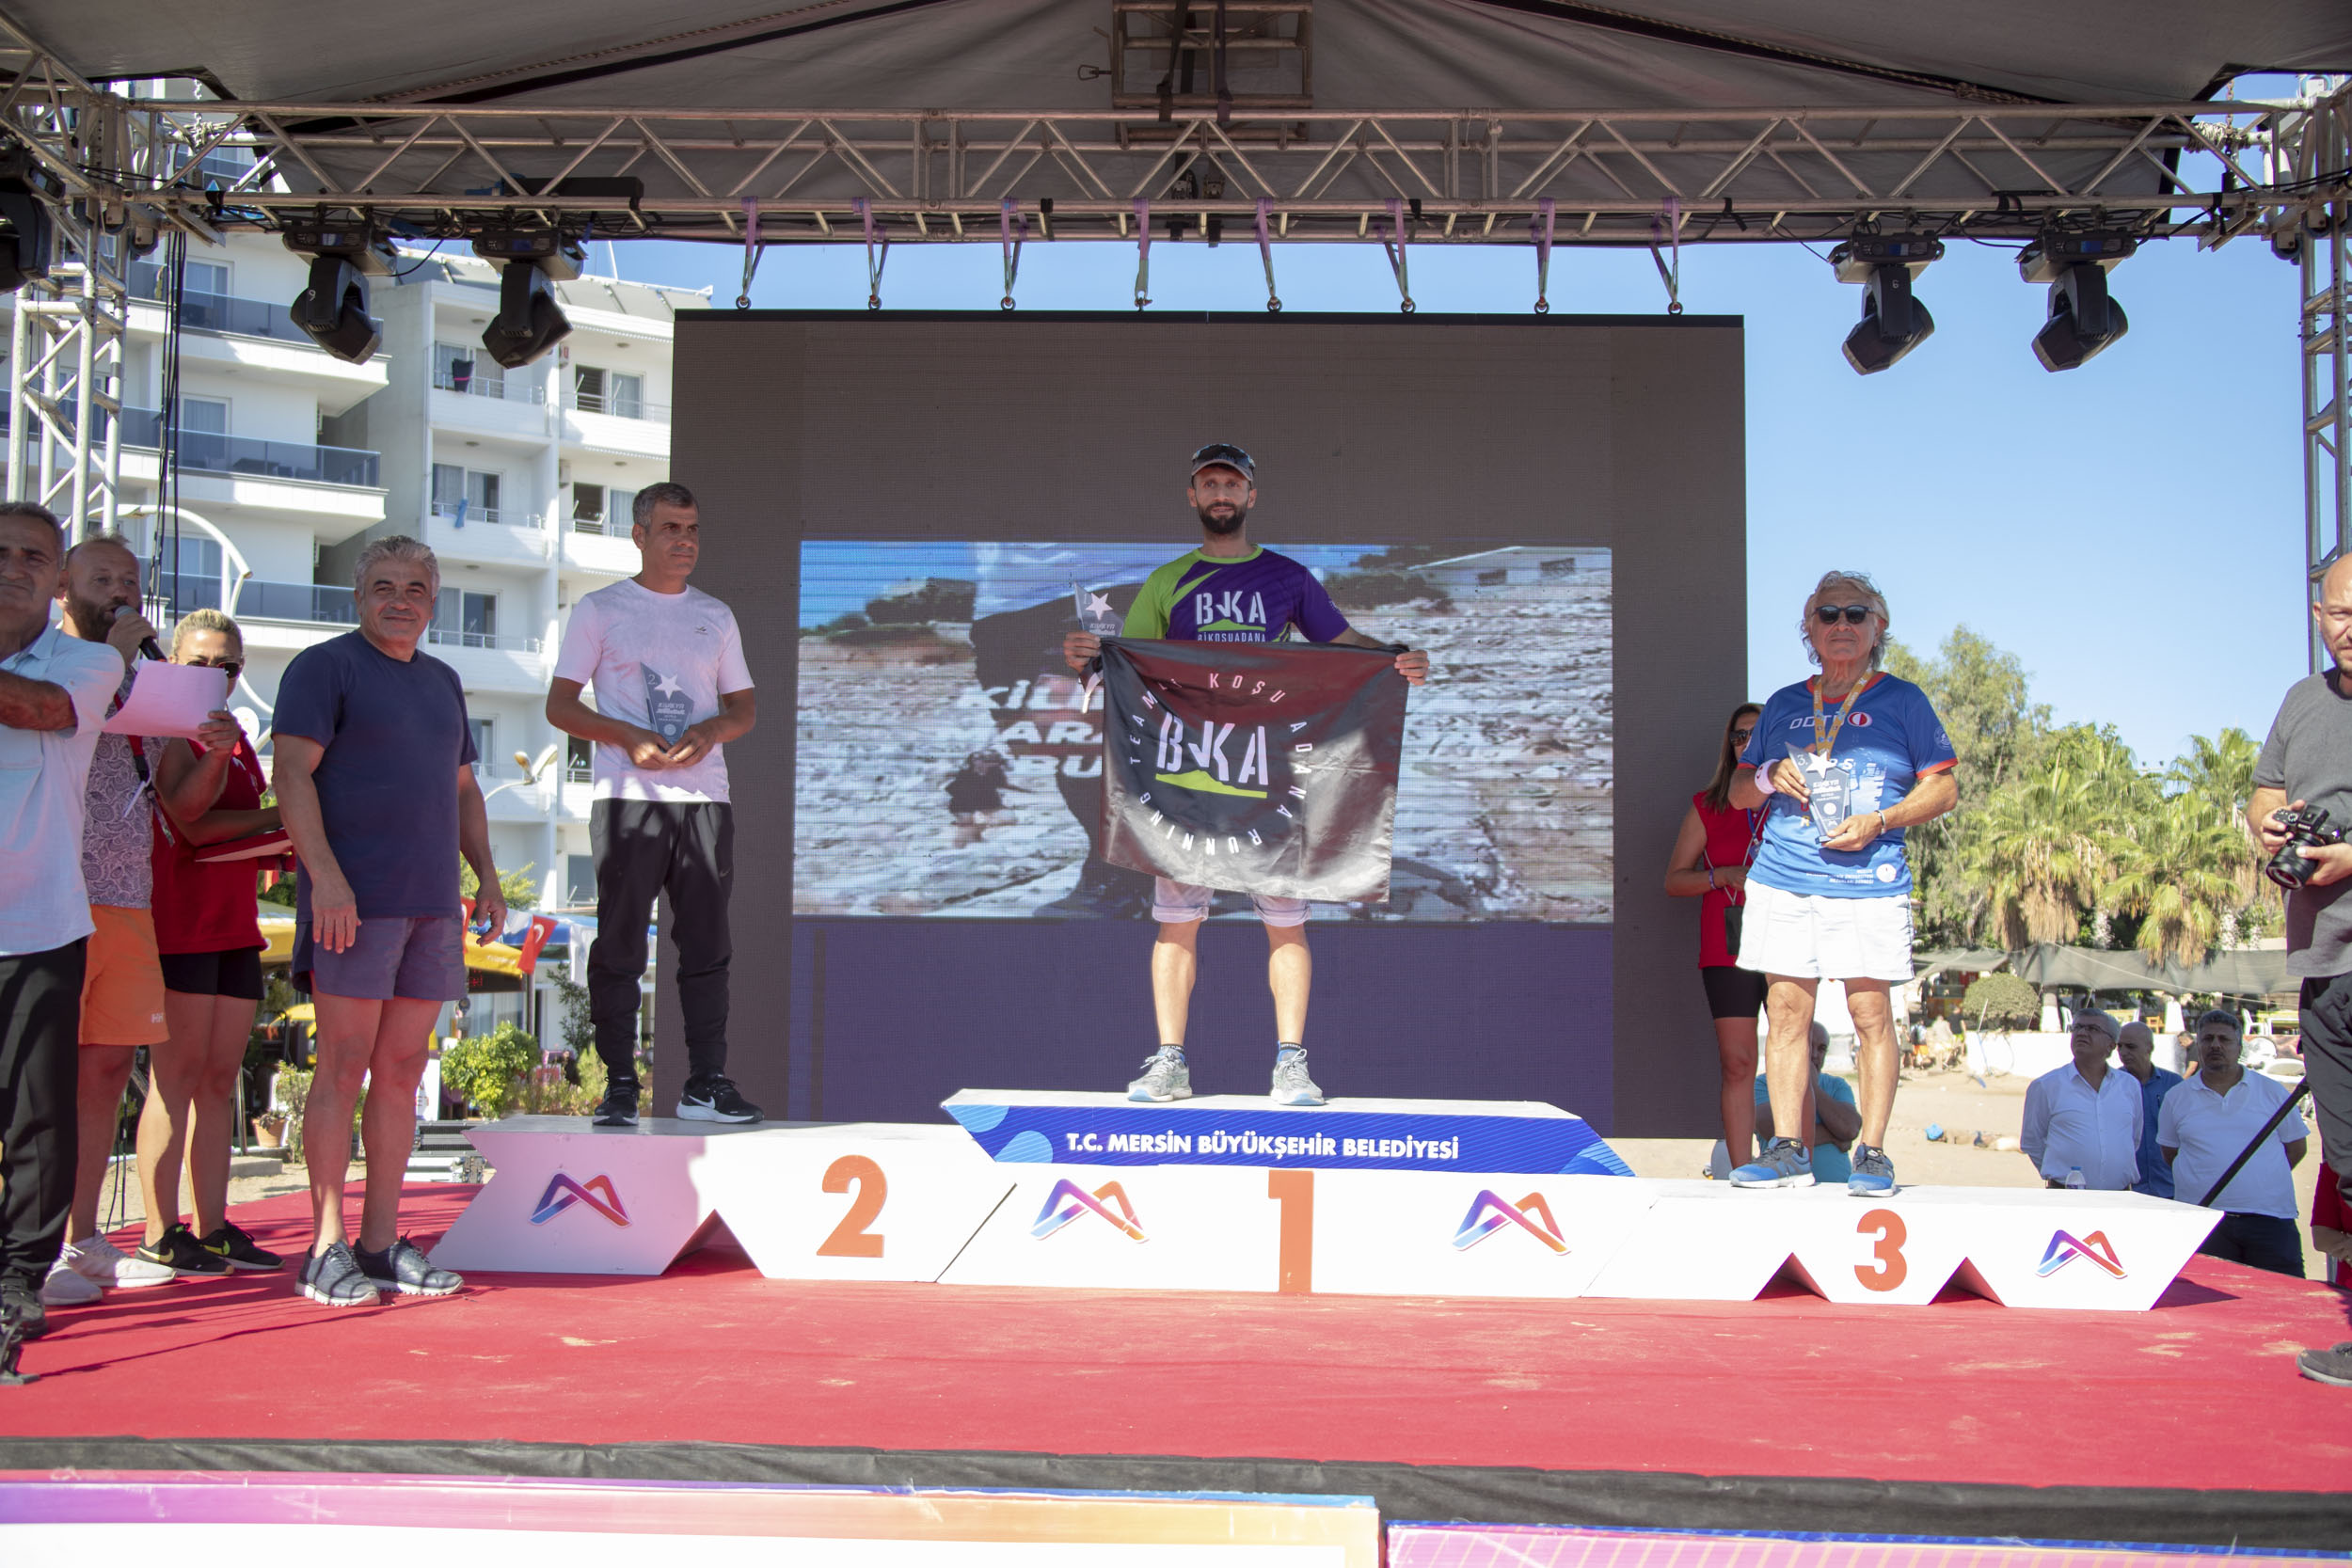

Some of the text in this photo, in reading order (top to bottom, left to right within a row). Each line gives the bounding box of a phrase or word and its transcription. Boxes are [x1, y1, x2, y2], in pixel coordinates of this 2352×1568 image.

[1066, 1130, 1459, 1160] T.C. MERSİN BÜYÜKŞEHİR BELEDİYESİ
[816, 1154, 888, 1259] 2
[1268, 1169, 1313, 1293] 1
[1853, 1208, 1907, 1292] 3
